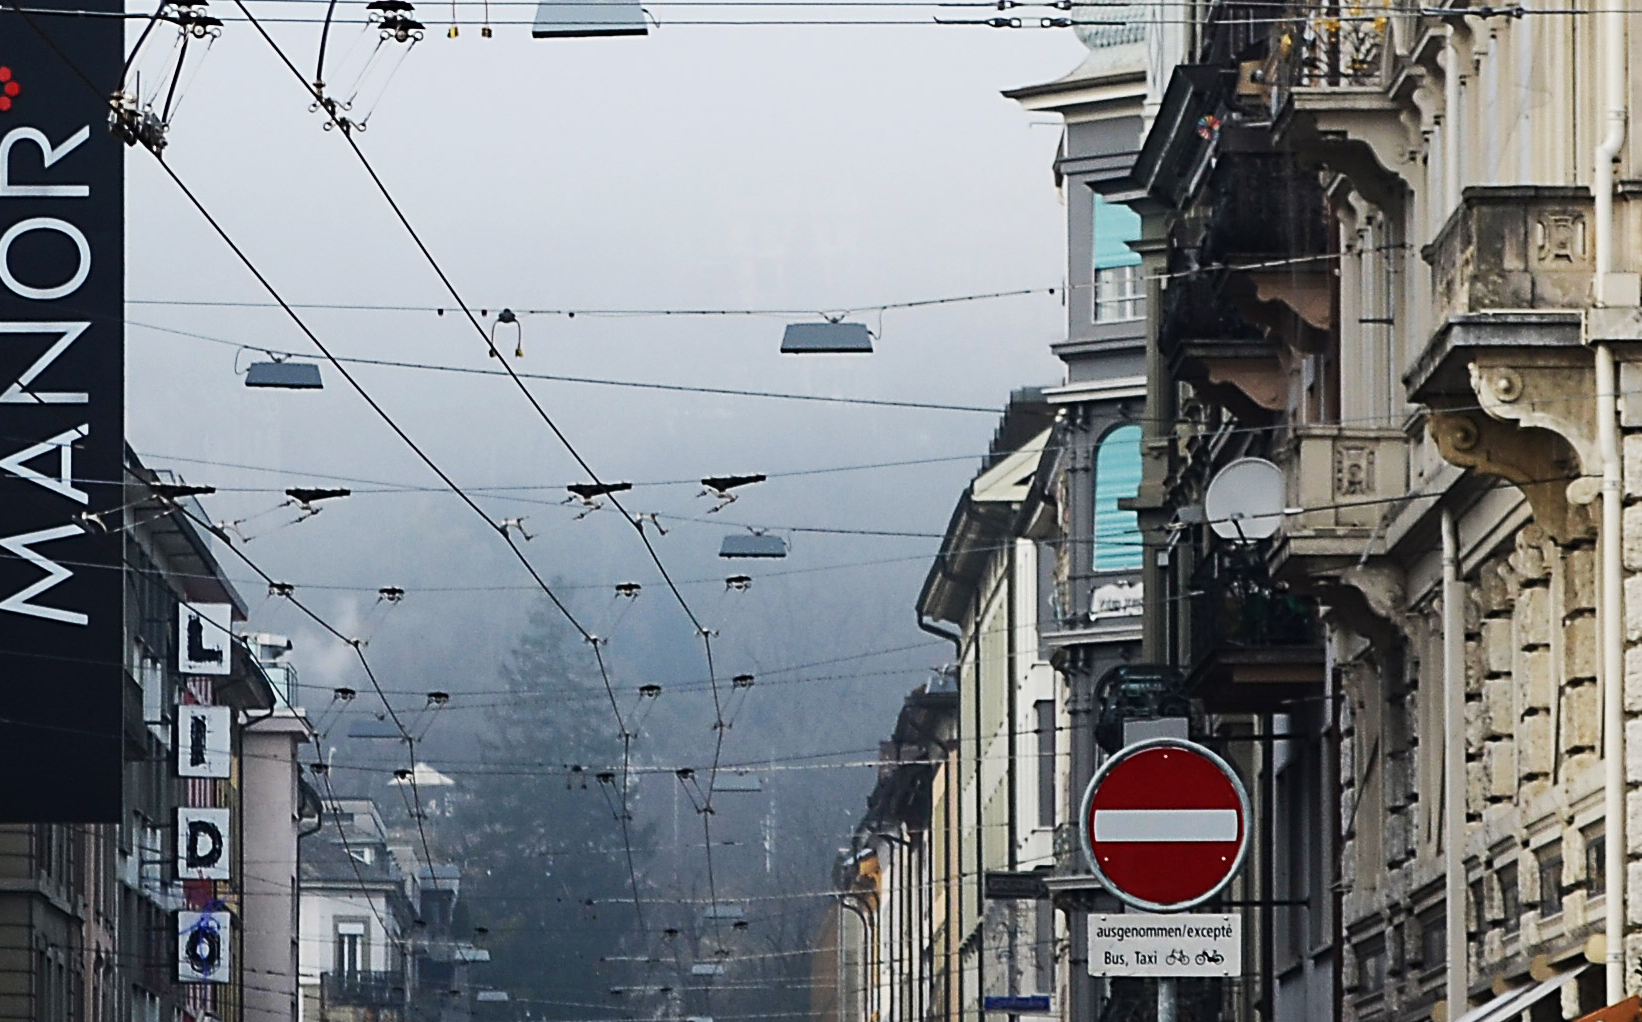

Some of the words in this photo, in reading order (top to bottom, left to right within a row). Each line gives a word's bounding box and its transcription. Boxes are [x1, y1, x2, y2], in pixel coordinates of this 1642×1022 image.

[1096, 924, 1233, 942] ausgenommen/excepté
[1104, 951, 1129, 966] Bus,
[1134, 951, 1157, 965] Taxi
